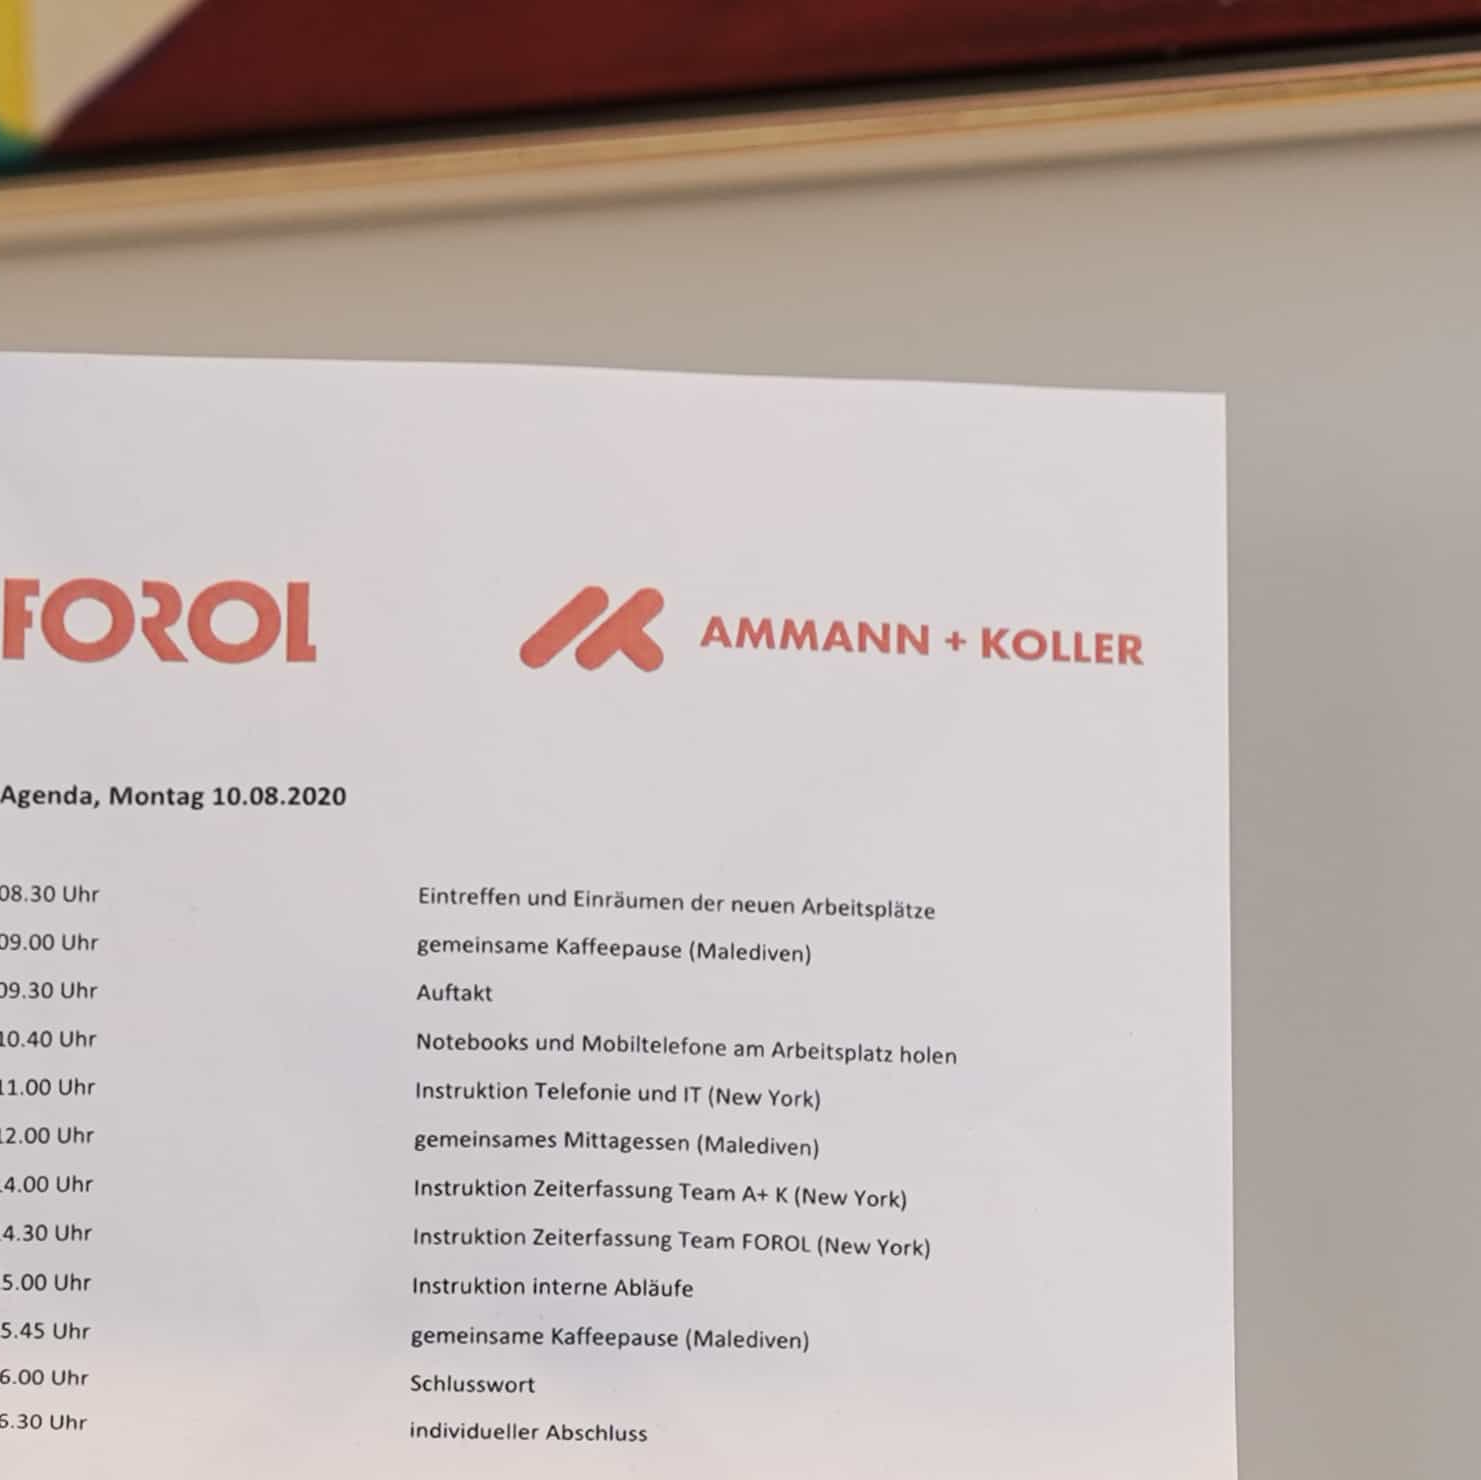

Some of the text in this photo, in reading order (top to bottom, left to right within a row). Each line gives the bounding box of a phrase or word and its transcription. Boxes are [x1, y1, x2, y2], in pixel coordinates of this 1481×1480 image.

[2, 576, 318, 663] FOROL
[700, 614, 1144, 665] AMMANN + KOLLER
[0, 783, 347, 811] Agenda, Montag 10.08.2020
[62, 883, 101, 904] Uhr
[418, 886, 936, 922] Eintreffen und Einräumen der neuen Arbeitsplätze
[61, 932, 100, 952] Uhr
[416, 935, 812, 967] gemeinsame Kaffeepause (Malediven)
[60, 980, 99, 1000] Uhr
[415, 982, 494, 1003] Auftakt
[59, 1029, 97, 1049] Uhr
[416, 1031, 958, 1066] Notebooks und Mobiltelefone am Arbeitsplatz holen
[58, 1076, 97, 1097] Uhr
[415, 1080, 821, 1113] Instruktion Telefonie und IT (New York)
[56, 1125, 96, 1145] Uhr
[413, 1129, 820, 1161] gemeinsames Mittagessen (Malediven)
[55, 1174, 95, 1194] Uhr
[414, 1177, 527, 1198] Instruktion
[532, 1178, 674, 1204] Zeiterfassung
[677, 1182, 736, 1202] Team
[794, 1185, 849, 1209] (New
[853, 1189, 908, 1213] York)
[54, 1223, 94, 1243] Uhr
[413, 1226, 931, 1261] Instruktion Zeiterfassung Team FOROL (New York)
[53, 1271, 93, 1292] Uhr
[412, 1275, 694, 1299] Instruktion interne Abläufe
[52, 1321, 92, 1341] Uhr
[410, 1325, 810, 1354] gemeinsame Kaffeepause (Malediven)
[51, 1368, 90, 1387] Uhr
[409, 1373, 536, 1395] Schlusswort
[49, 1413, 89, 1431] Uhr
[409, 1421, 649, 1443] individueller Abschluss
